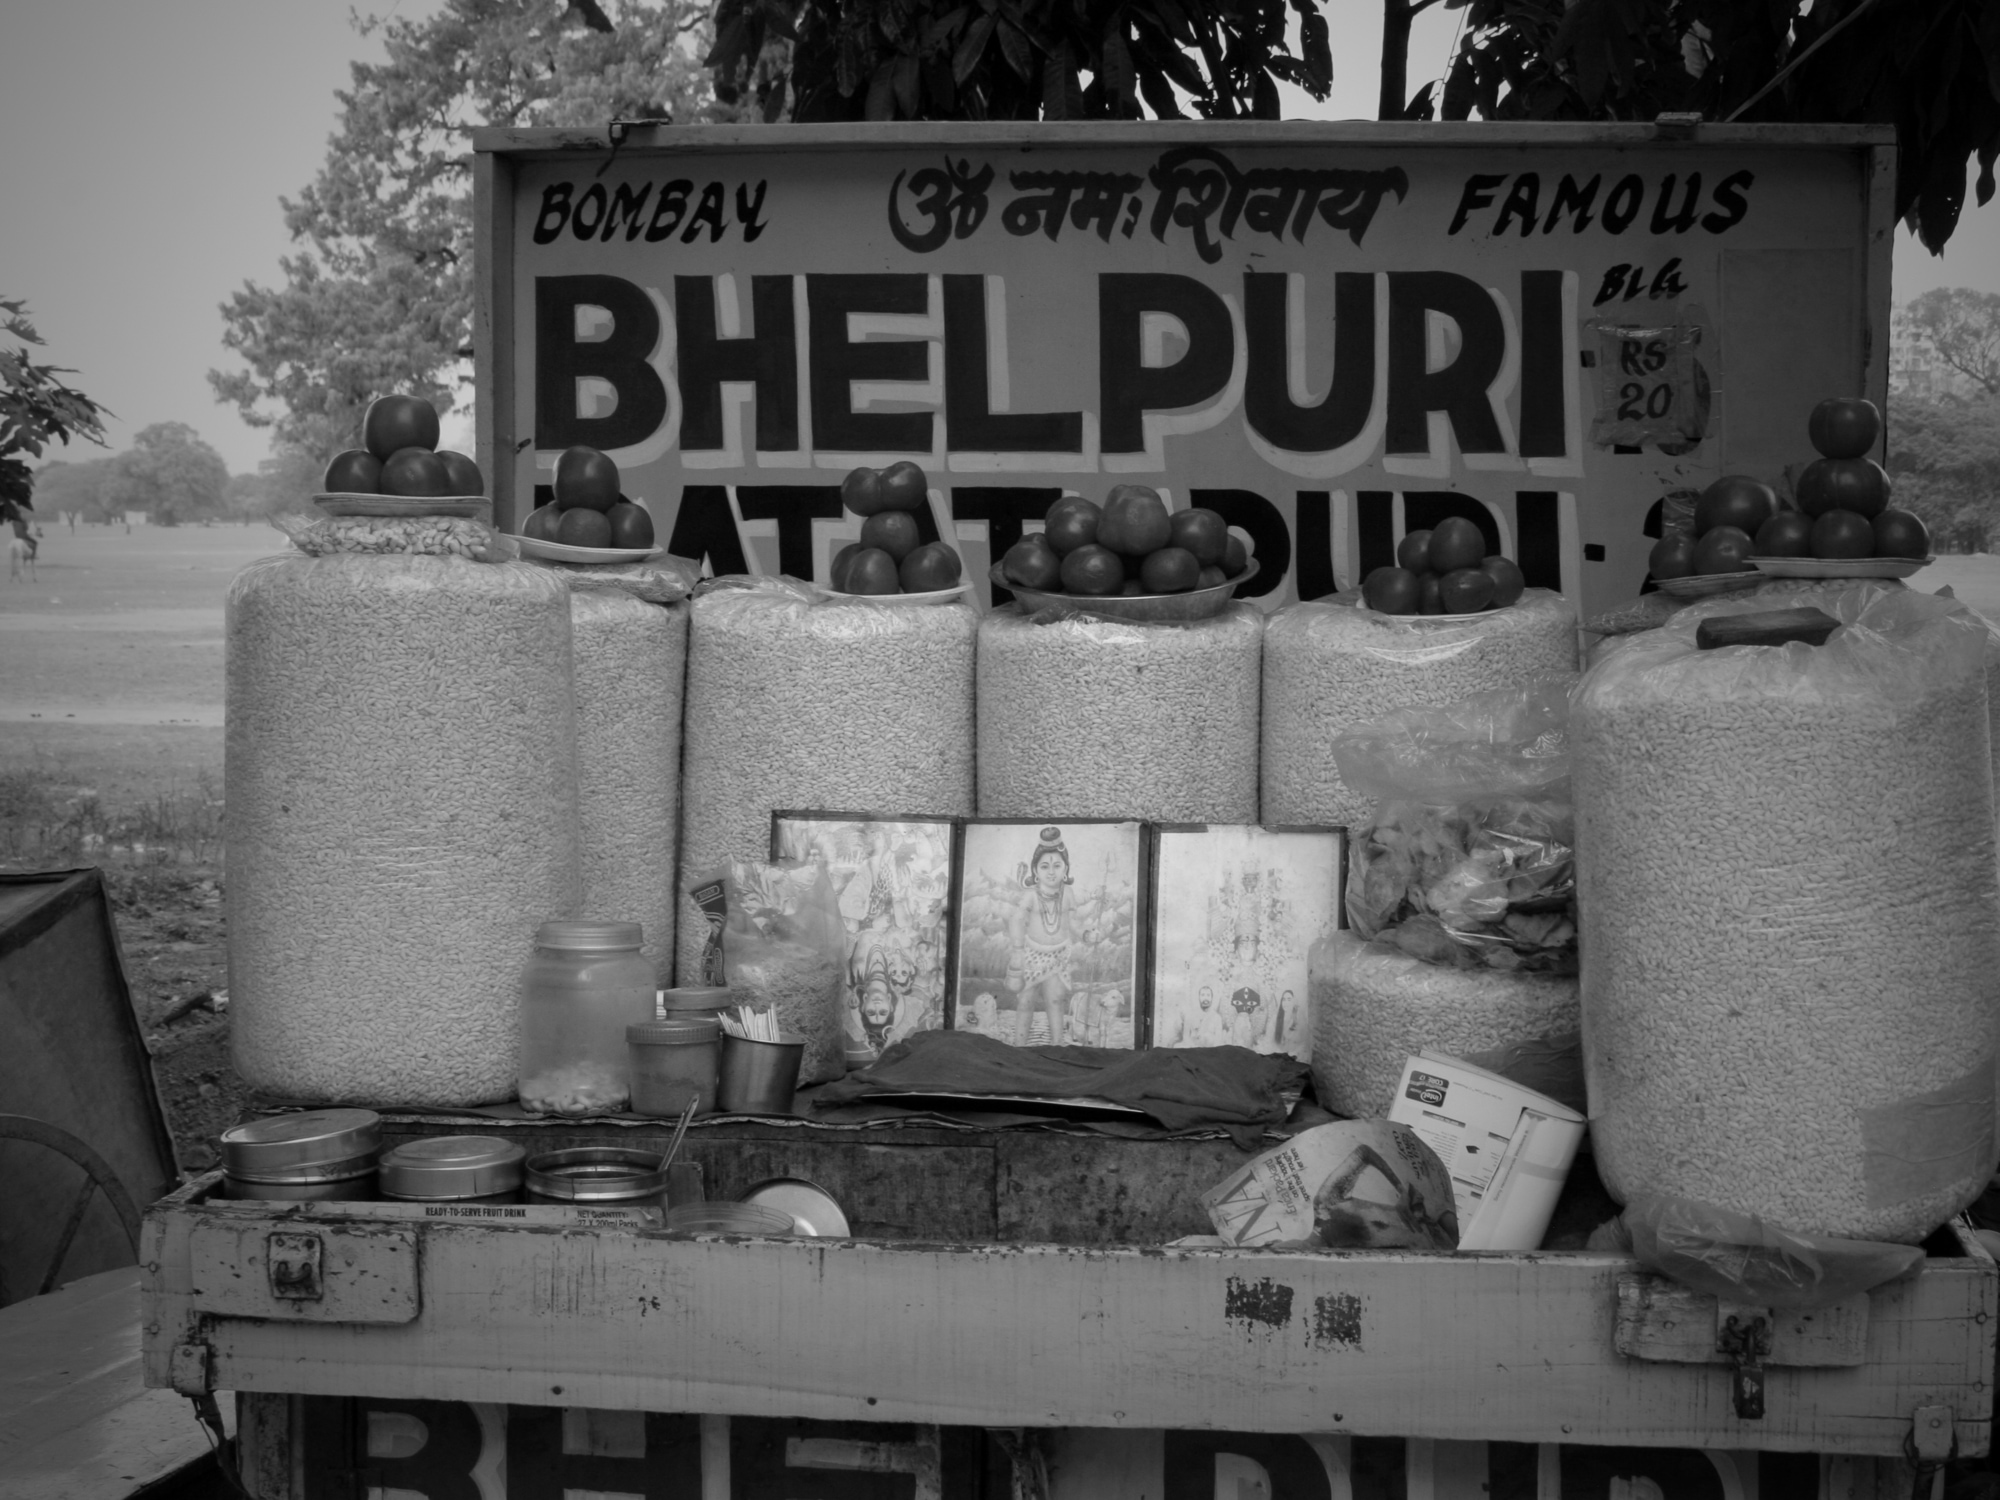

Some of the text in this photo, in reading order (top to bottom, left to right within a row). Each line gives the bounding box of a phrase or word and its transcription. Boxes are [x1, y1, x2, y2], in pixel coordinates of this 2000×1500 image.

[533, 178, 769, 245] BOMBAY
[1148, 145, 1409, 265] शिवाय
[1447, 169, 1756, 238] FAMOUS
[1620, 338, 1668, 378] RS
[1617, 382, 1675, 422] 20
[425, 1207, 527, 1218] READY-TO-SERVE FRUIT DRINK
[577, 1210, 591, 1219] NET
[618, 1219, 639, 1228] Packs
